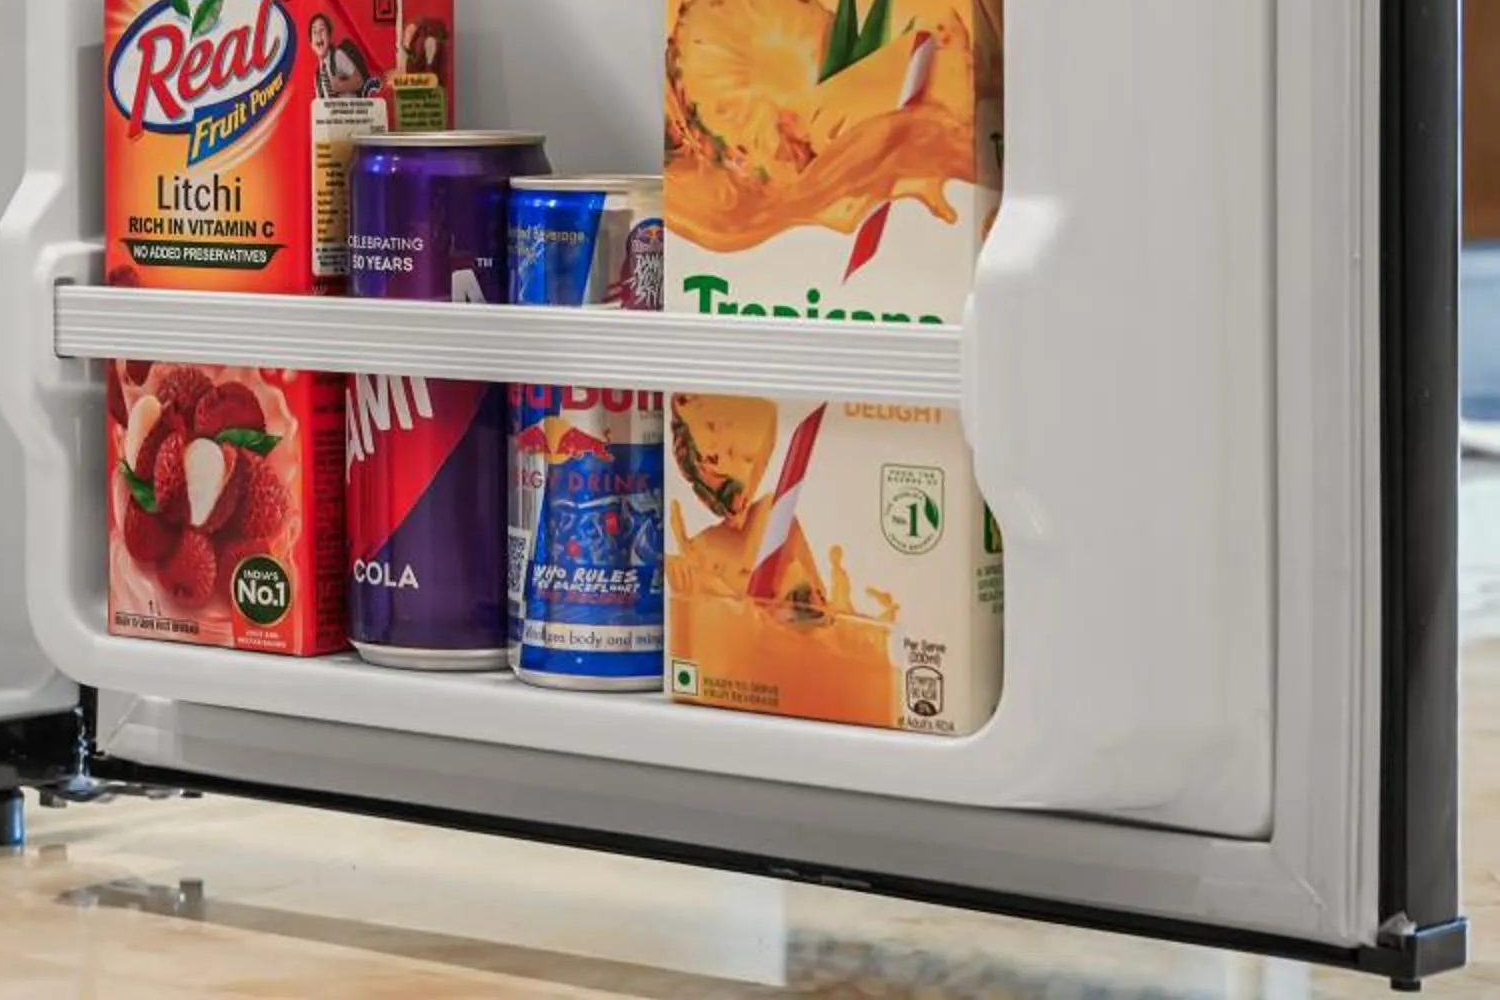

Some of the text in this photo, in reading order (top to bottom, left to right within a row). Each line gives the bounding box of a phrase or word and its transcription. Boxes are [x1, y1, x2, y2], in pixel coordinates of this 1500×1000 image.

[190, 101, 248, 161] Fruit
[157, 173, 242, 213] Litchi
[129, 216, 275, 238] RICH IN VITAMIN C
[347, 234, 424, 251] CELEBRATING
[133, 244, 267, 264] NO ADDED PRESERVATIVES
[366, 255, 414, 272] YEARS
[353, 558, 419, 590] COLA
[573, 567, 639, 583] RULES
[237, 578, 285, 607] No.1
[569, 631, 603, 649] body
[606, 631, 633, 649] and
